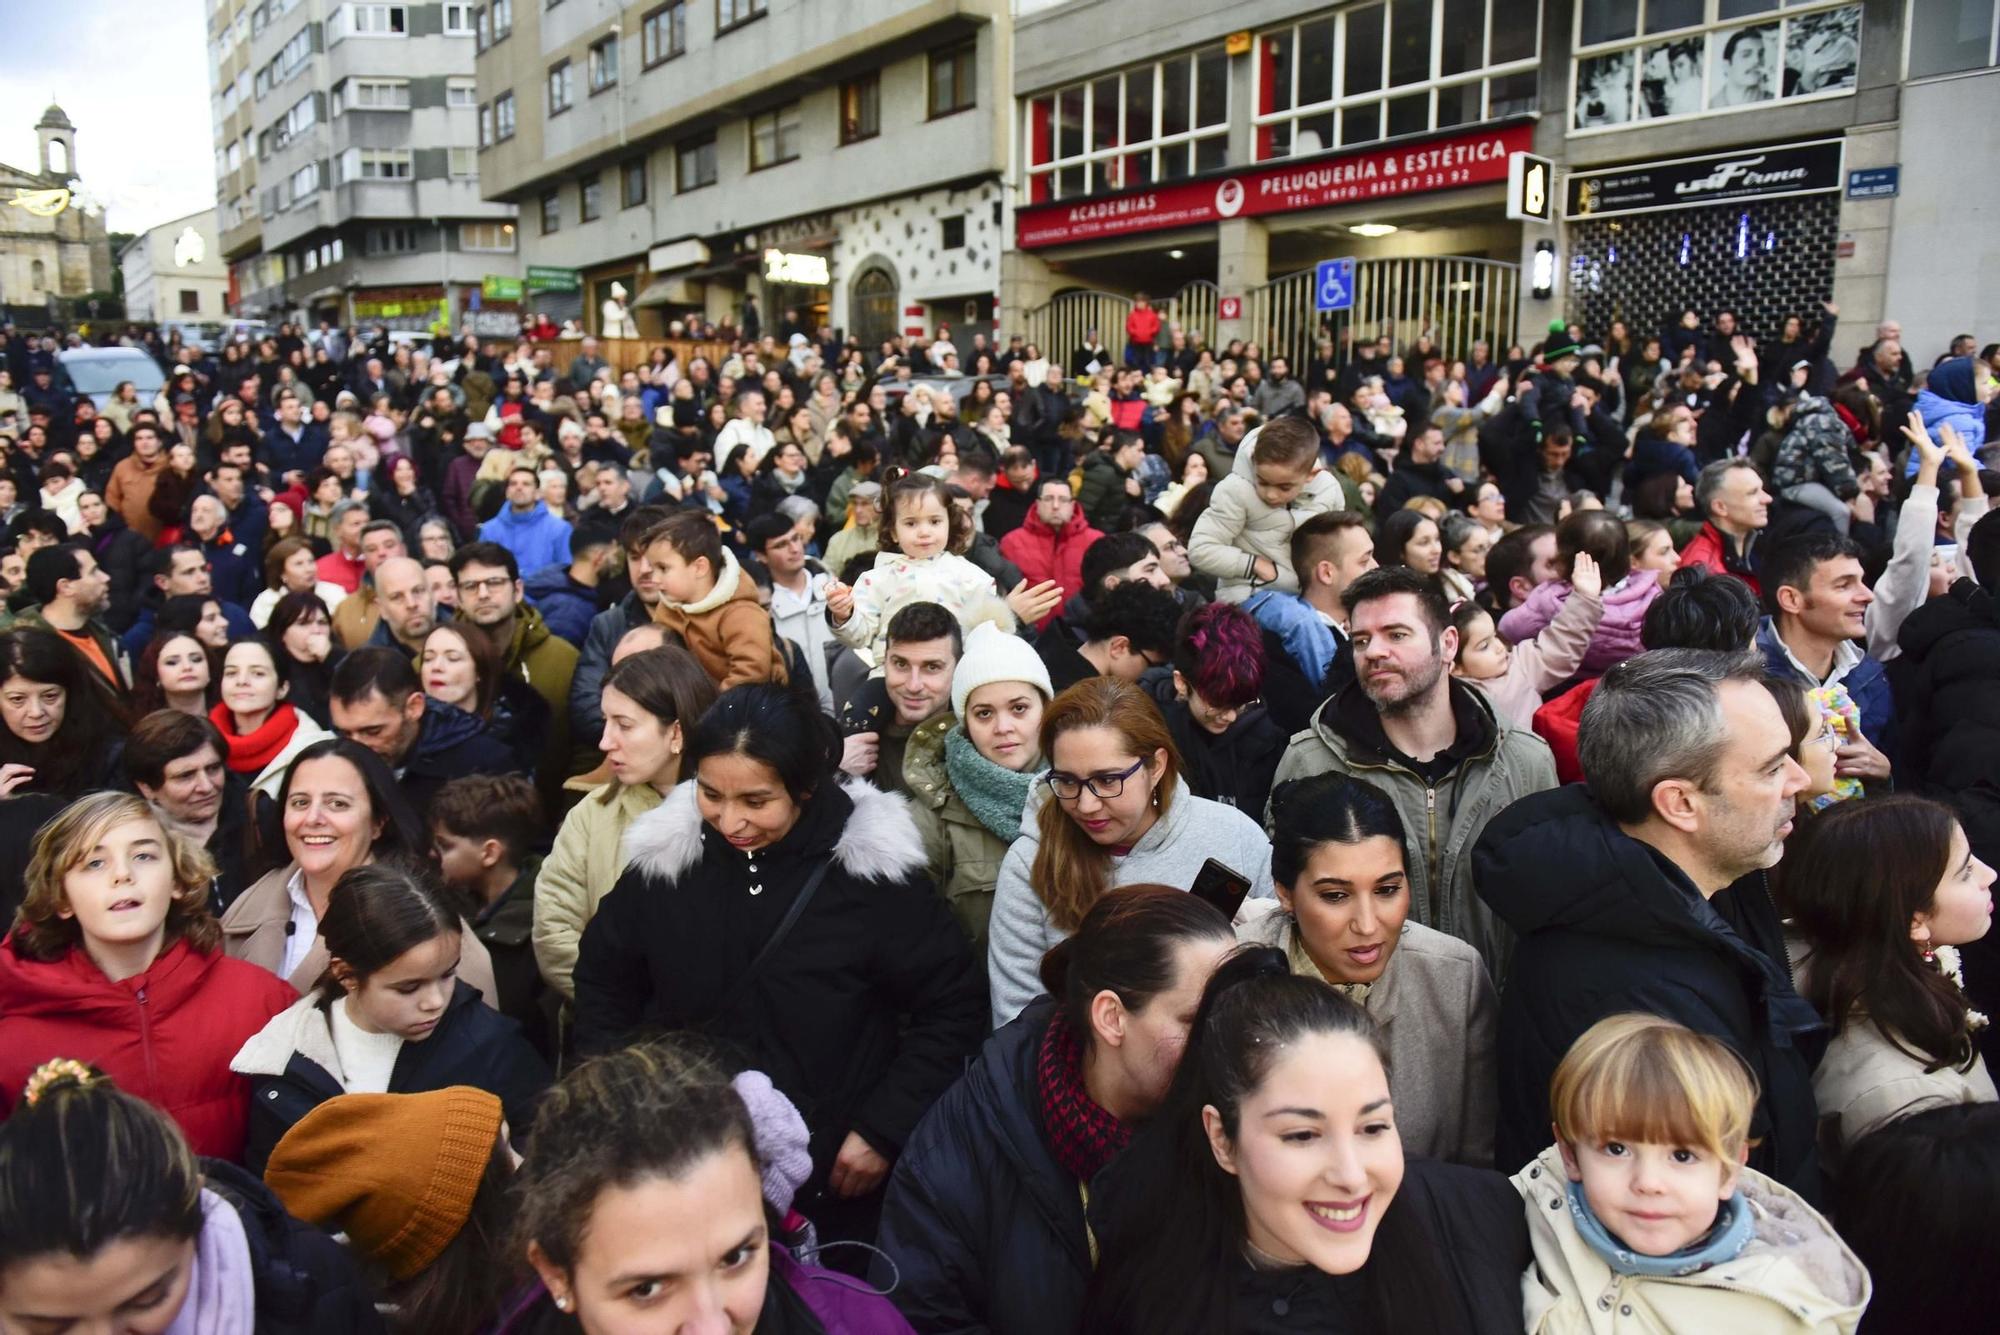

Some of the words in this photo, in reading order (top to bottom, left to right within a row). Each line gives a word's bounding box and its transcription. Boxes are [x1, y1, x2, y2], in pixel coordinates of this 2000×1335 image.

[1260, 158, 1378, 196] PELUQUERÍA
[1383, 157, 1398, 176] &
[1404, 139, 1506, 173] ESTÉTICA
[1068, 193, 1158, 222] ACADEMIAS
[1287, 193, 1316, 207] TEL.
[1323, 186, 1364, 201] INFO:
